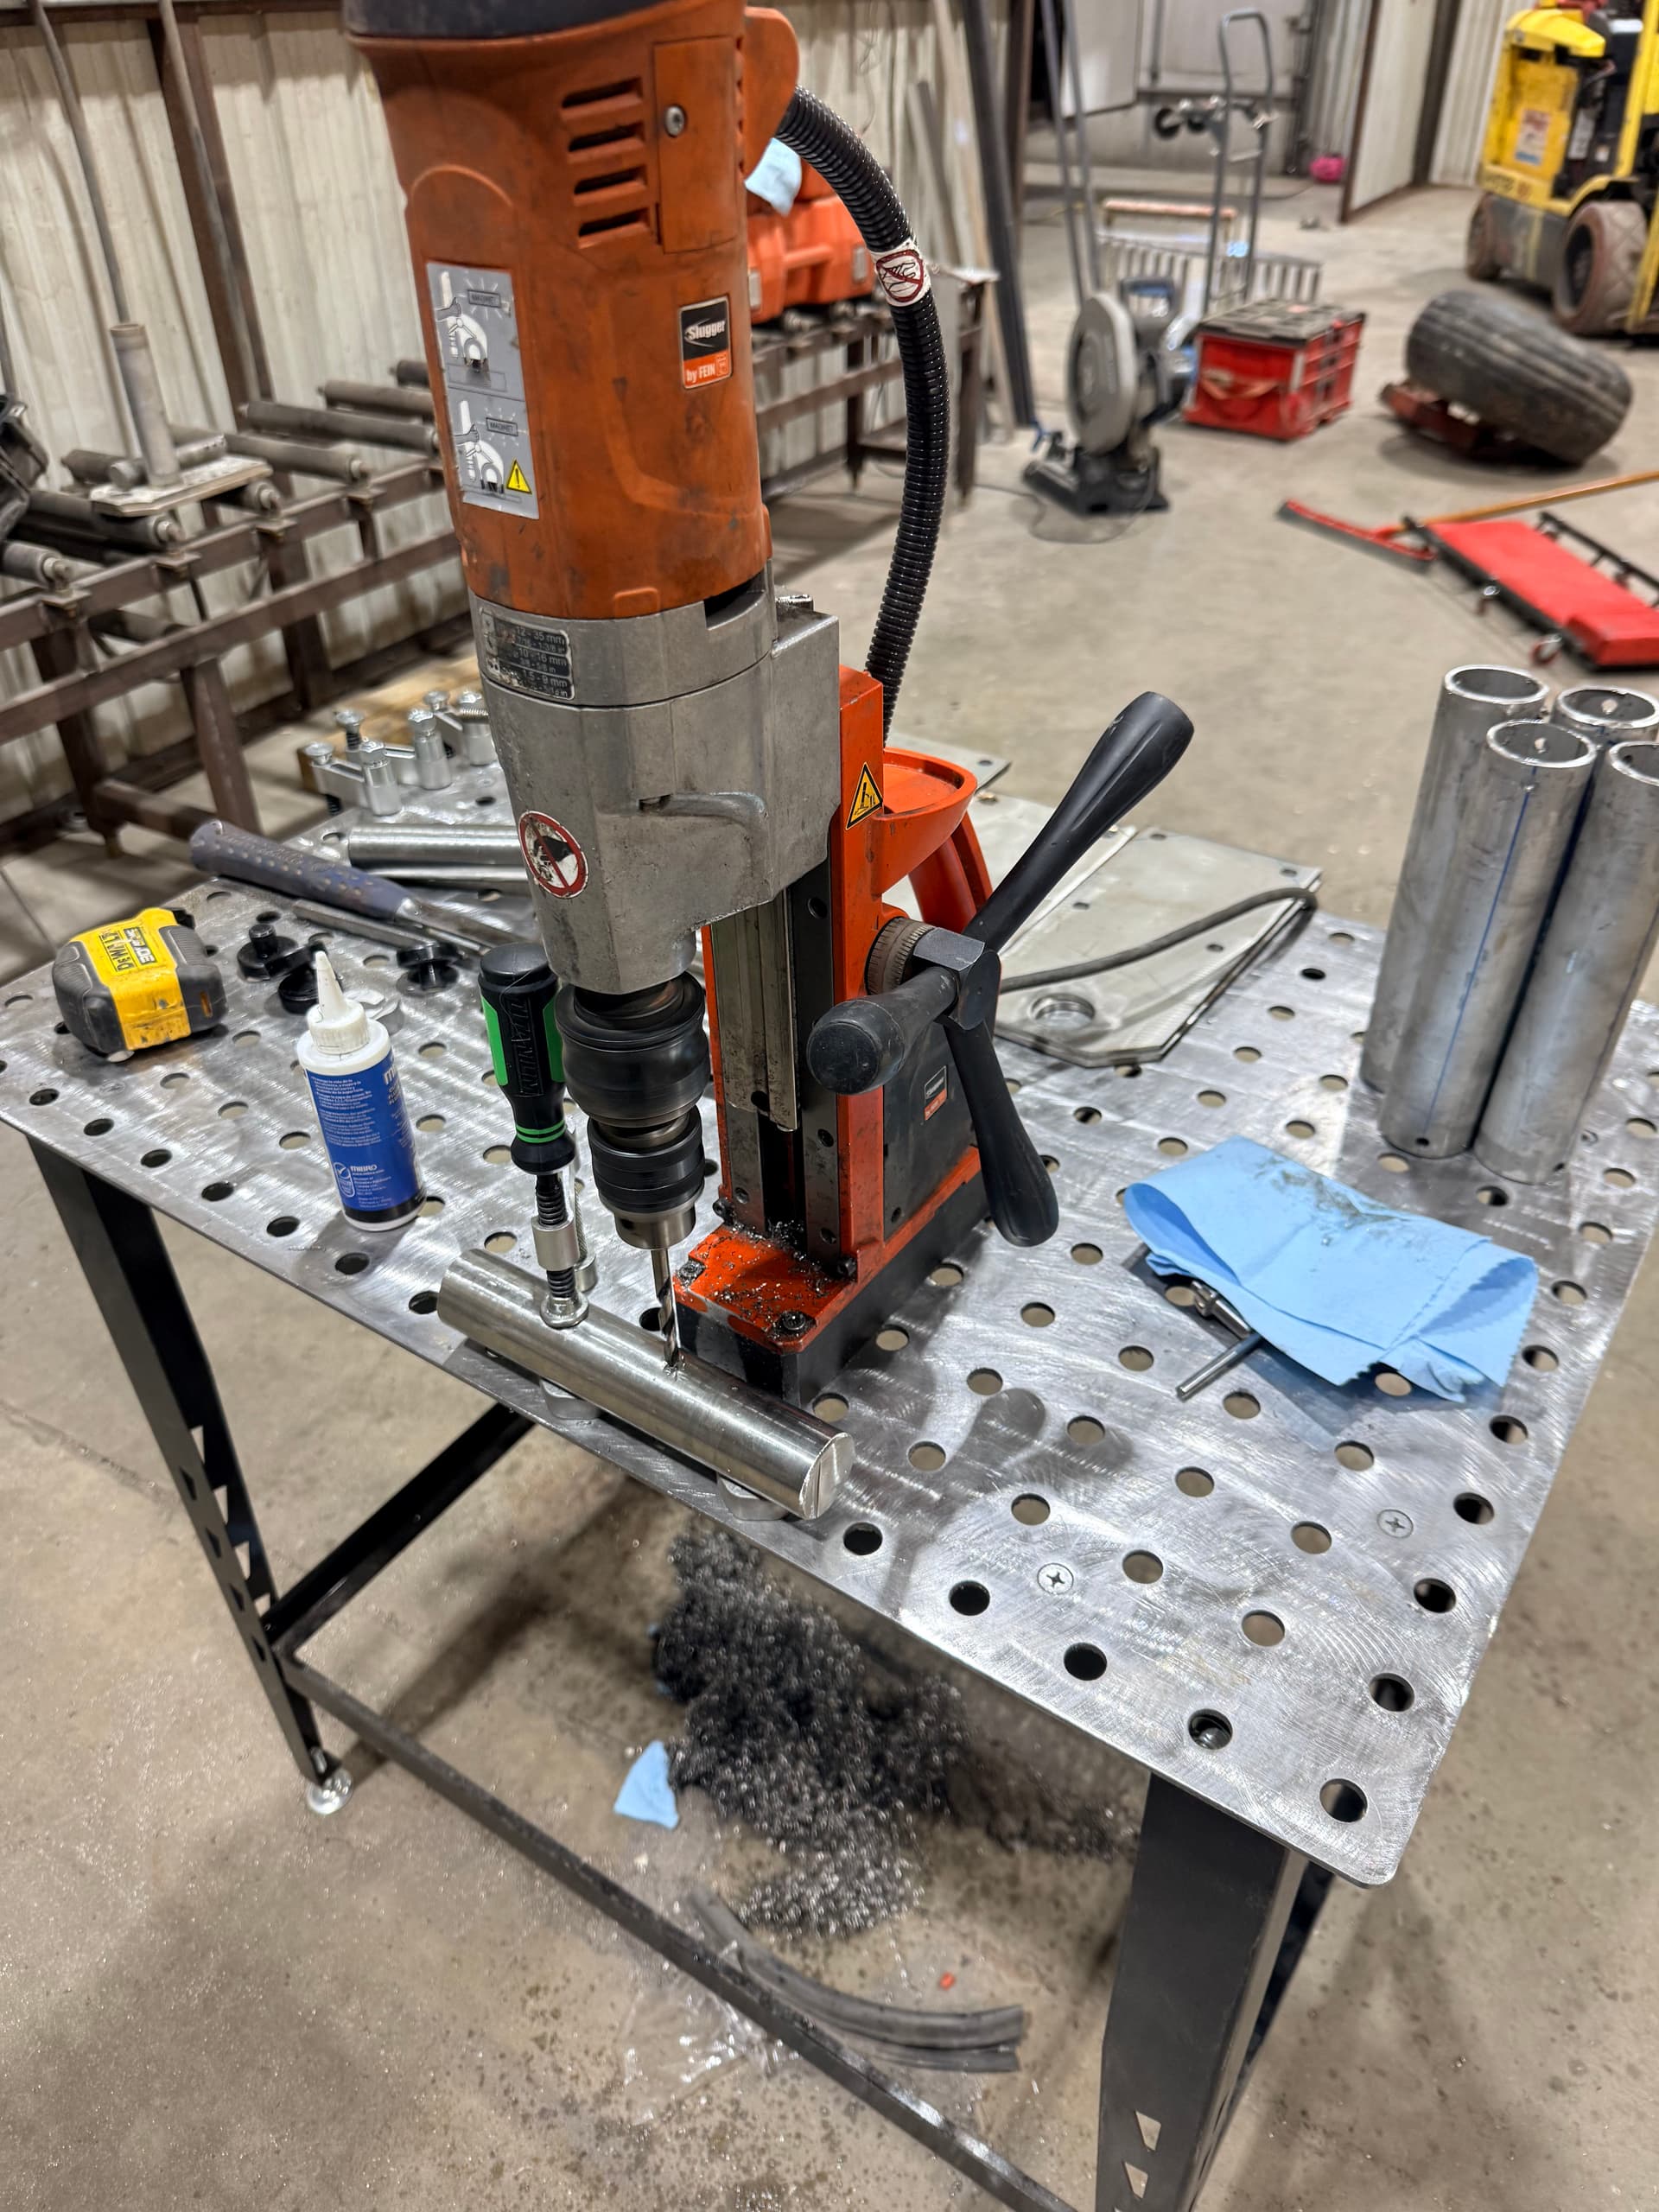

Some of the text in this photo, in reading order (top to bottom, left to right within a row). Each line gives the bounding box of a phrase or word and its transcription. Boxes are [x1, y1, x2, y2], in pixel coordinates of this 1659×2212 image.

[686, 321, 725, 340] Slugger
[686, 369, 697, 383] by
[698, 363, 715, 379] FEIN
[534, 632, 545, 641] 35
[546, 634, 566, 645] mm
[519, 647, 529, 658] 10
[537, 652, 548, 663] 16
[549, 656, 568, 666] mm
[542, 674, 549, 684] 9
[550, 678, 568, 688] mm
